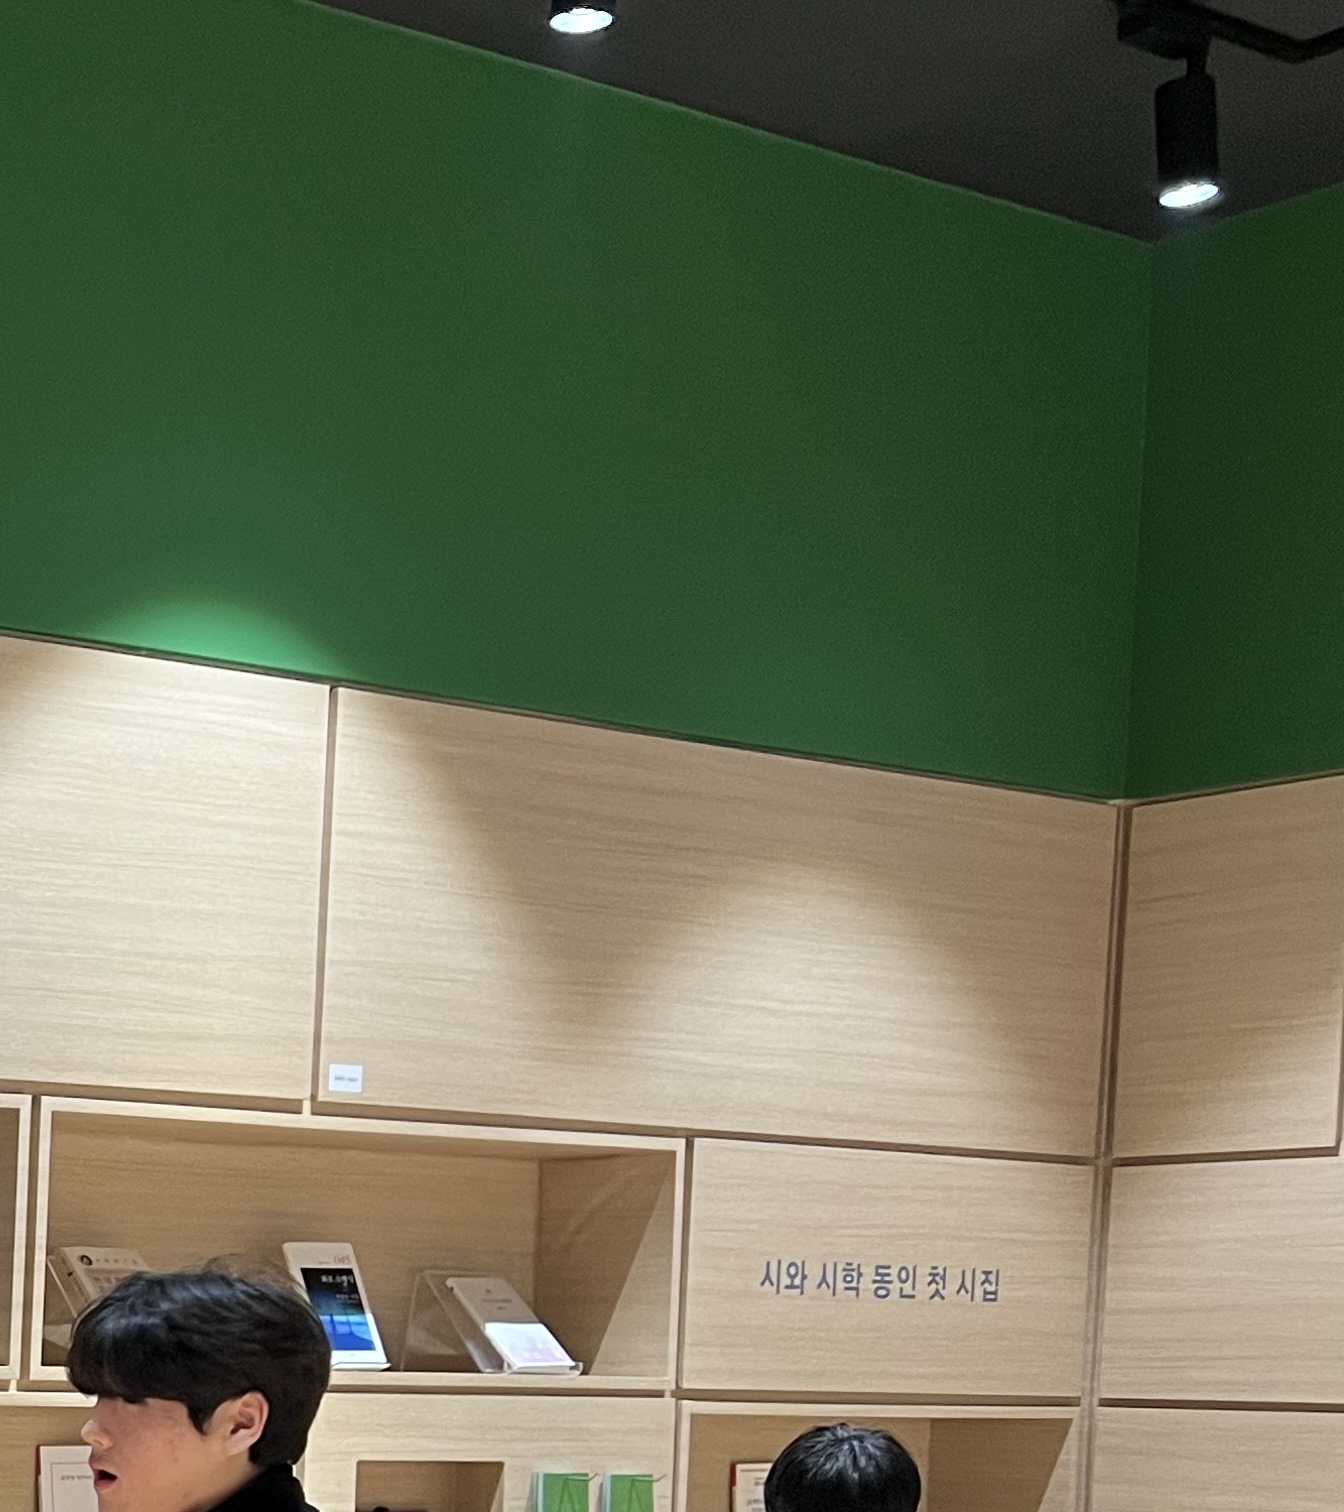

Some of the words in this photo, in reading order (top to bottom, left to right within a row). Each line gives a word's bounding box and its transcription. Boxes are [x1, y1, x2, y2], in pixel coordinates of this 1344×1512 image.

[759, 1259, 808, 1296] 시와
[816, 1261, 864, 1299] 시학
[871, 1264, 918, 1300] 동인
[926, 1265, 948, 1302] 첫
[955, 1267, 1001, 1303] 시집
